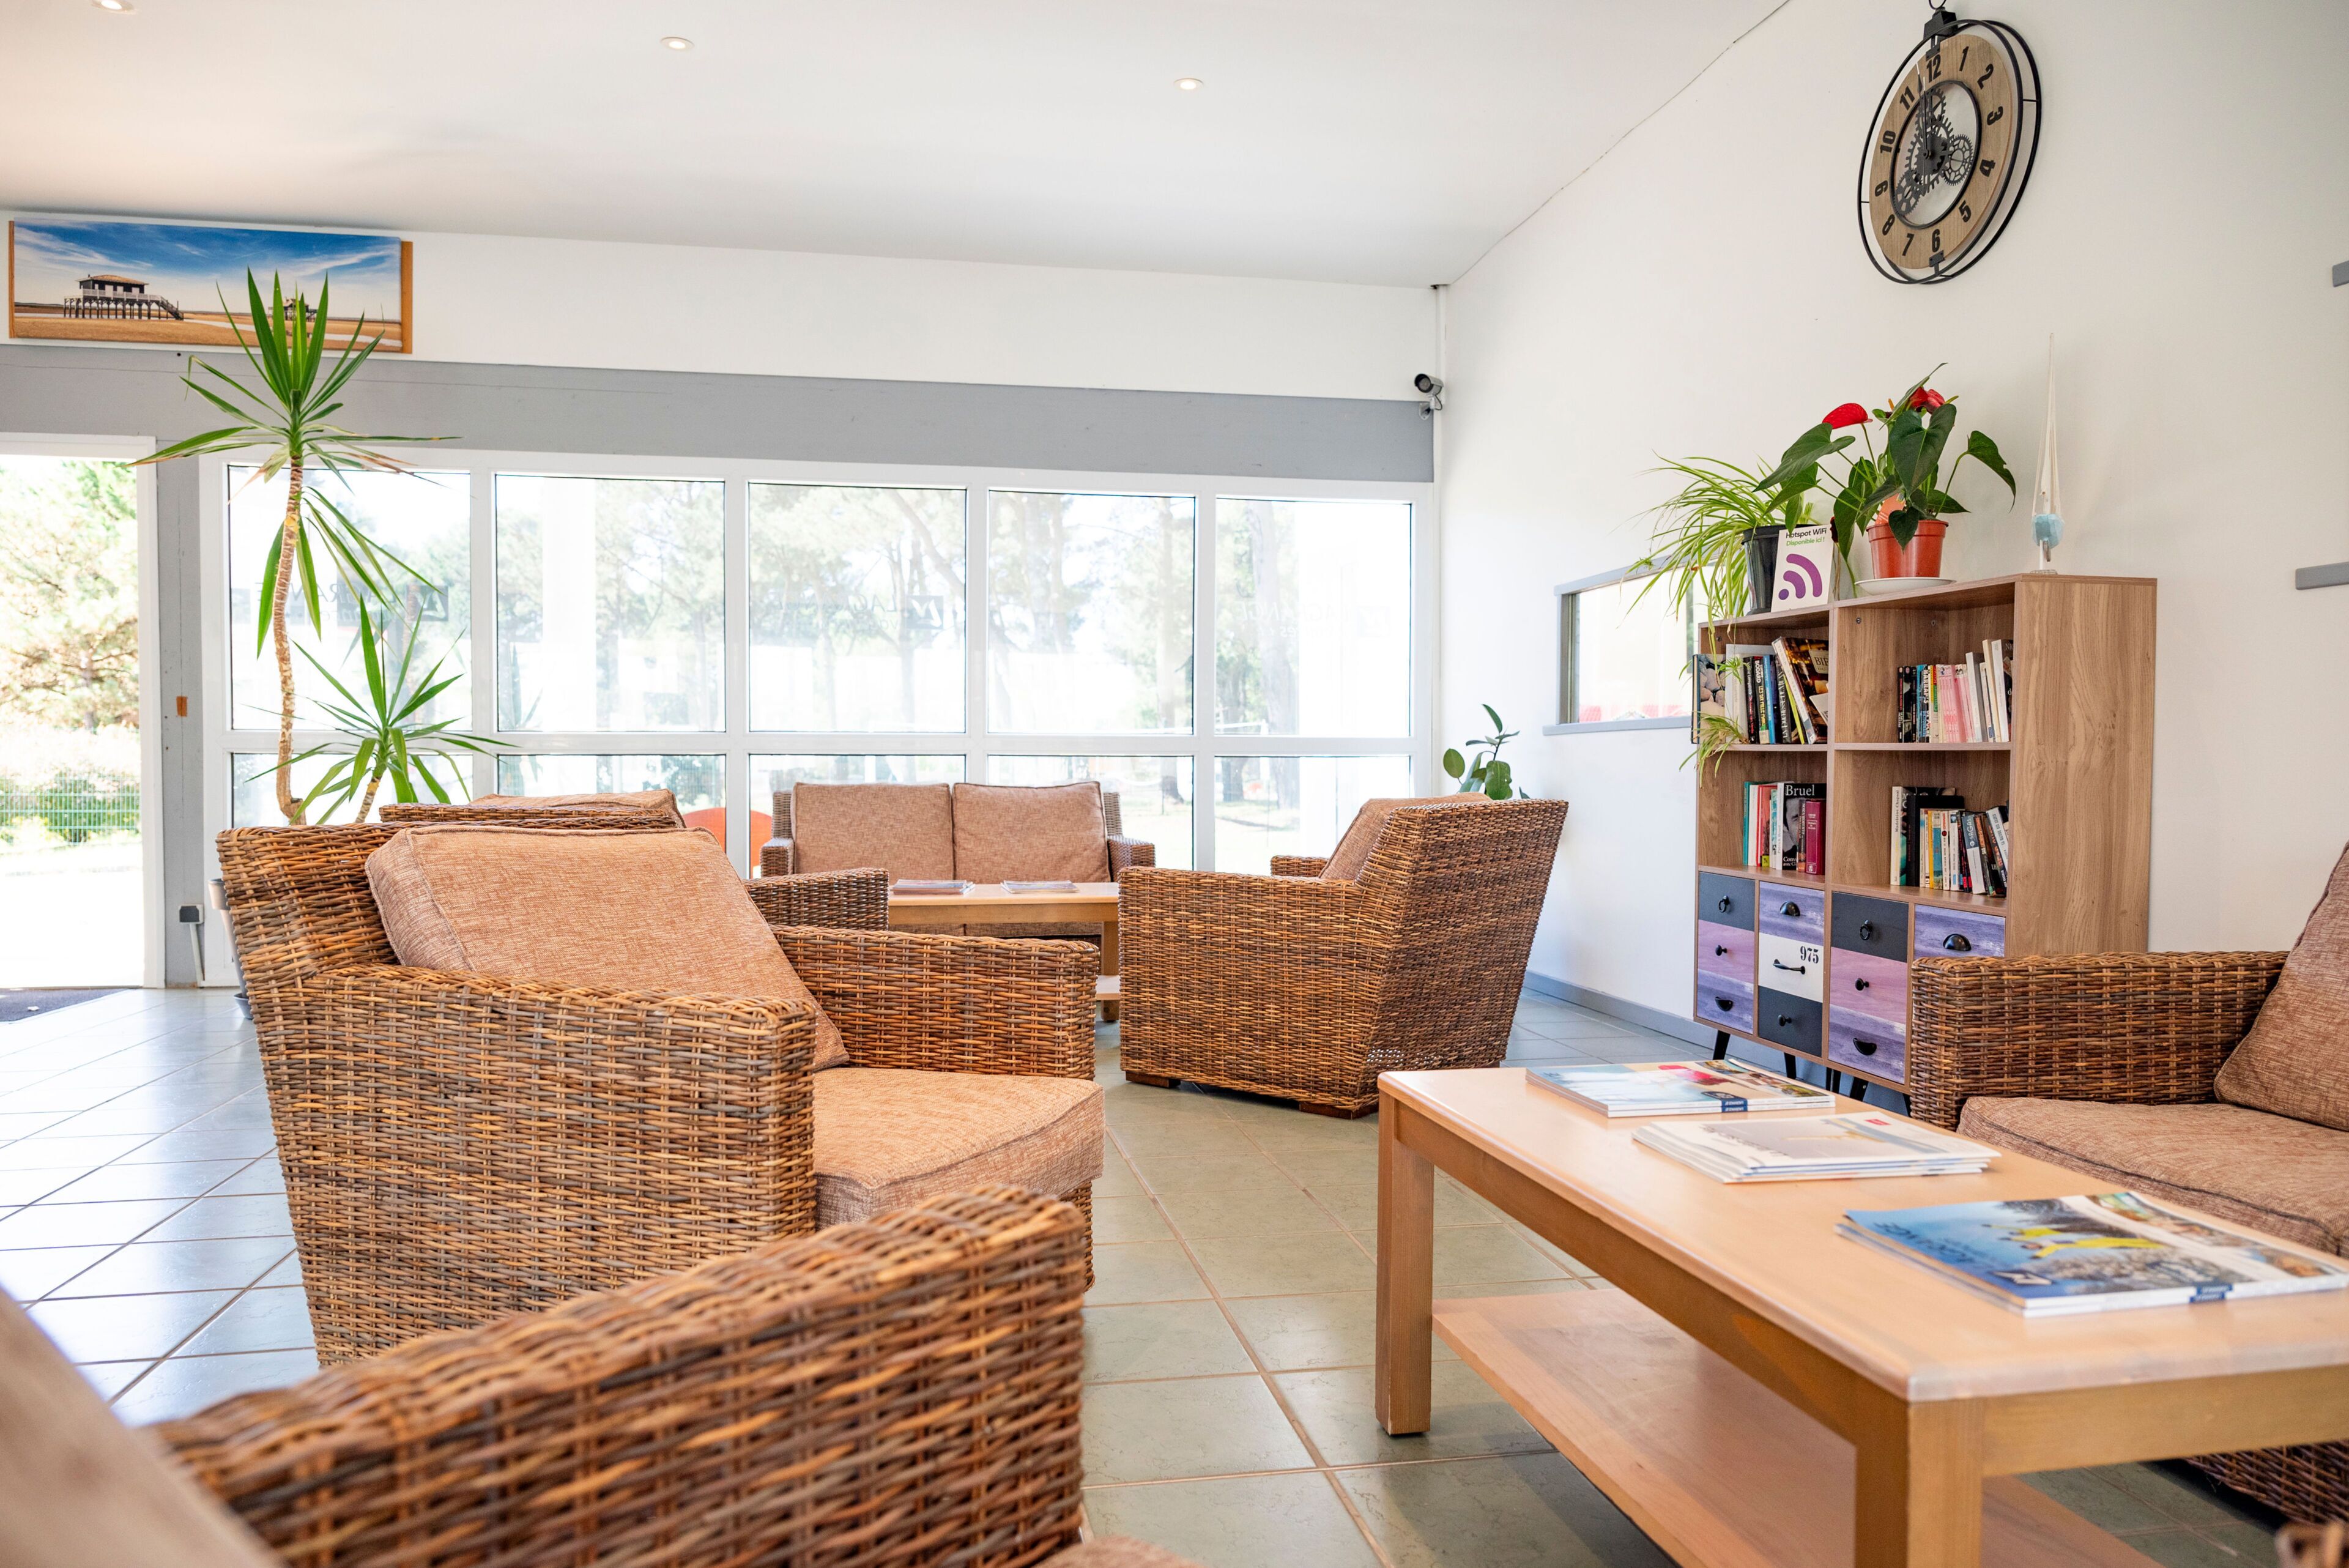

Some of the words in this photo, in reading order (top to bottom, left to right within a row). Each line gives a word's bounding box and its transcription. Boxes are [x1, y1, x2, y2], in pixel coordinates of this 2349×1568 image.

[1926, 54, 1941, 83] 12
[1959, 46, 1969, 72] 1
[1977, 64, 1994, 90] 2
[1899, 86, 1915, 110] 11
[1987, 106, 2003, 126] 3
[1880, 130, 1896, 154] 10
[1980, 159, 1996, 177] 4
[1874, 180, 1888, 198] 9
[1959, 200, 1972, 223] 5
[1882, 214, 1895, 236] 8
[1902, 233, 1915, 256] 7
[1931, 229, 1941, 253] 6
[1786, 530, 1811, 538] Hotspot
[1782, 730, 1787, 738] LA
[1786, 784, 1815, 796] Bruel
[1800, 945, 1819, 964] 975
